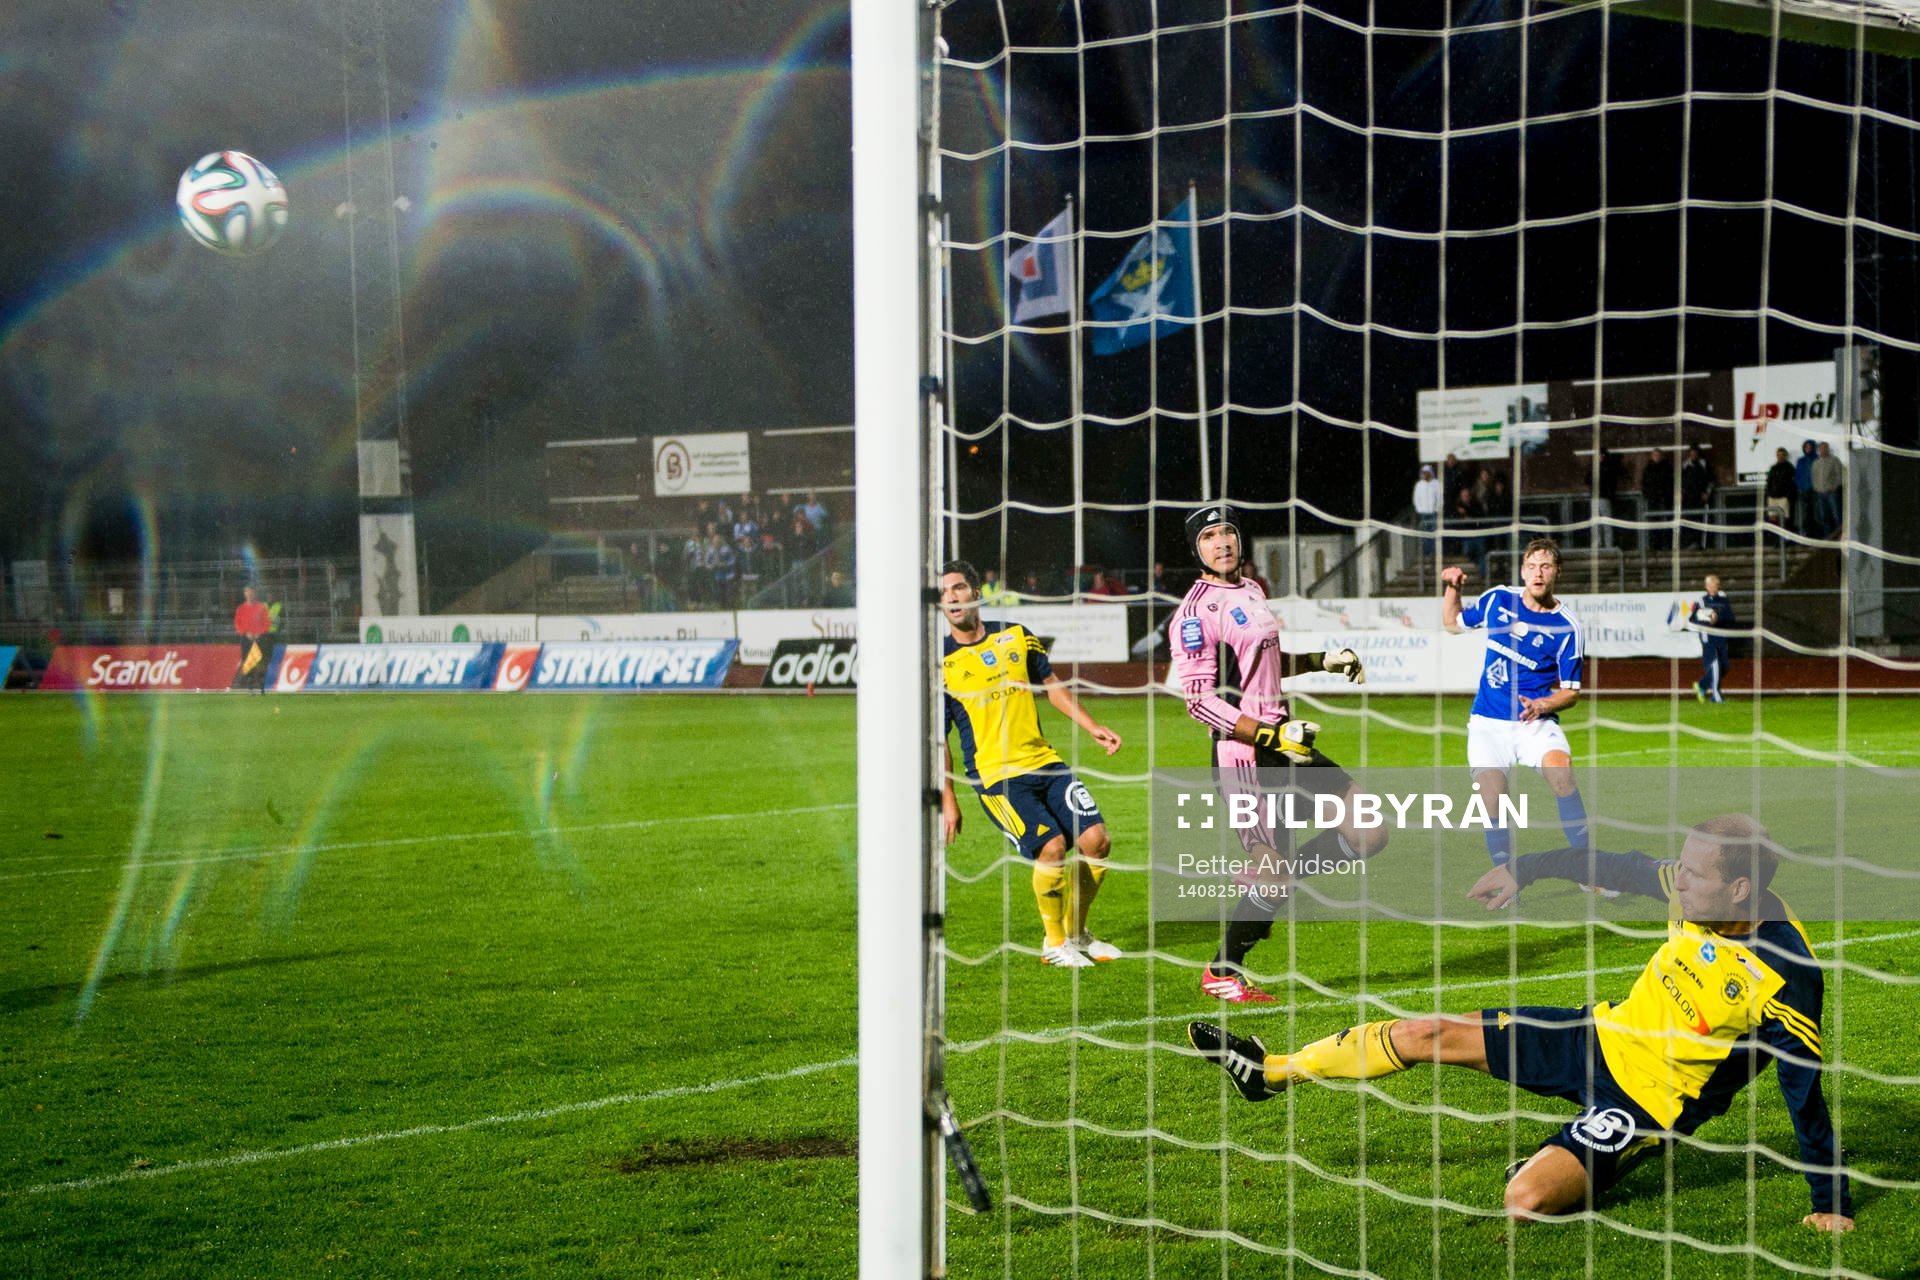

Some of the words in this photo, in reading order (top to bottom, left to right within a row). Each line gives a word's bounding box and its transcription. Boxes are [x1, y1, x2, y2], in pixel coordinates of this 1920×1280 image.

[87, 650, 188, 686] Scandic
[313, 648, 476, 686] STRYKTIPSET
[537, 644, 713, 684] STRYKTIPSET
[1662, 974, 1696, 1021] COLOR
